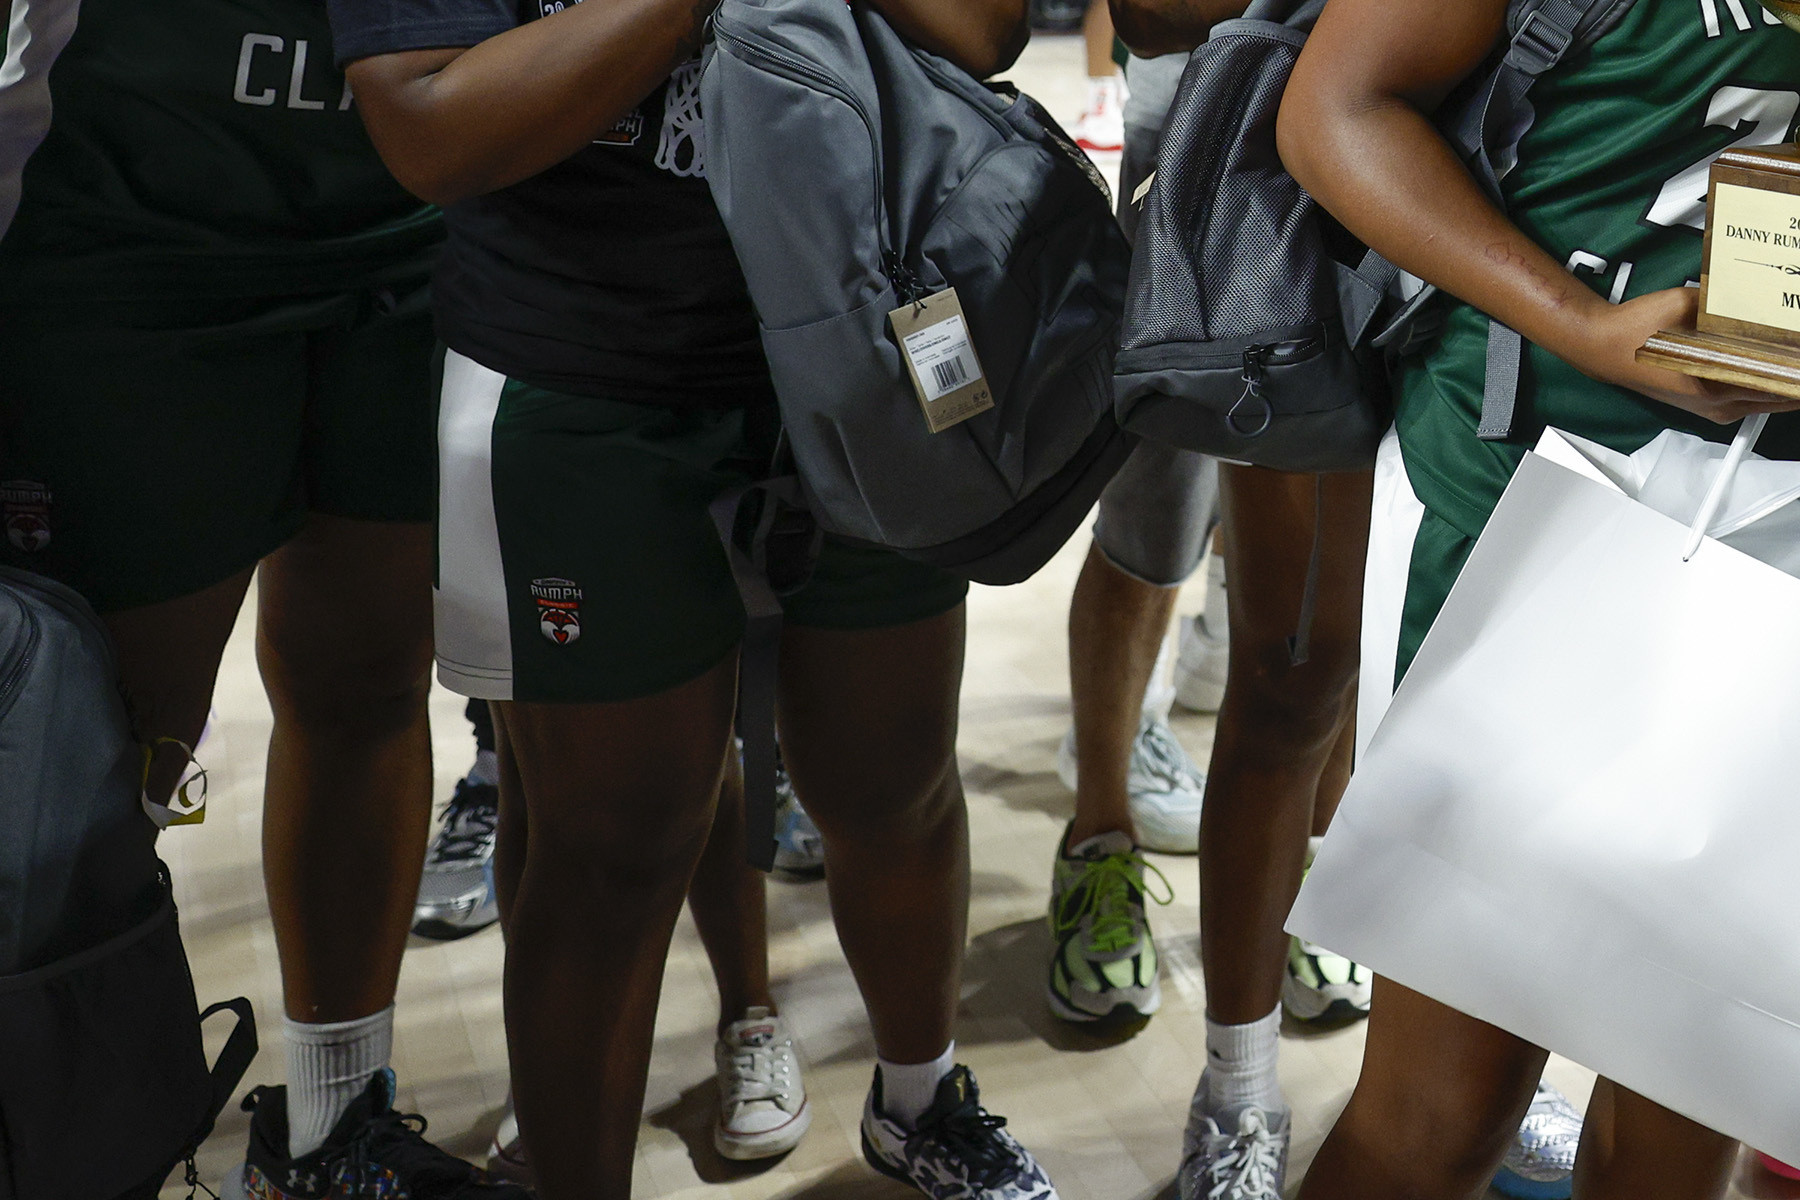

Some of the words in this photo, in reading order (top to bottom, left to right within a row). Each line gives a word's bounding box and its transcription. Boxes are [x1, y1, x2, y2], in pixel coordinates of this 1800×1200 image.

[233, 32, 354, 111] CL
[1725, 224, 1771, 244] DANNY
[530, 584, 583, 600] RUMPH
